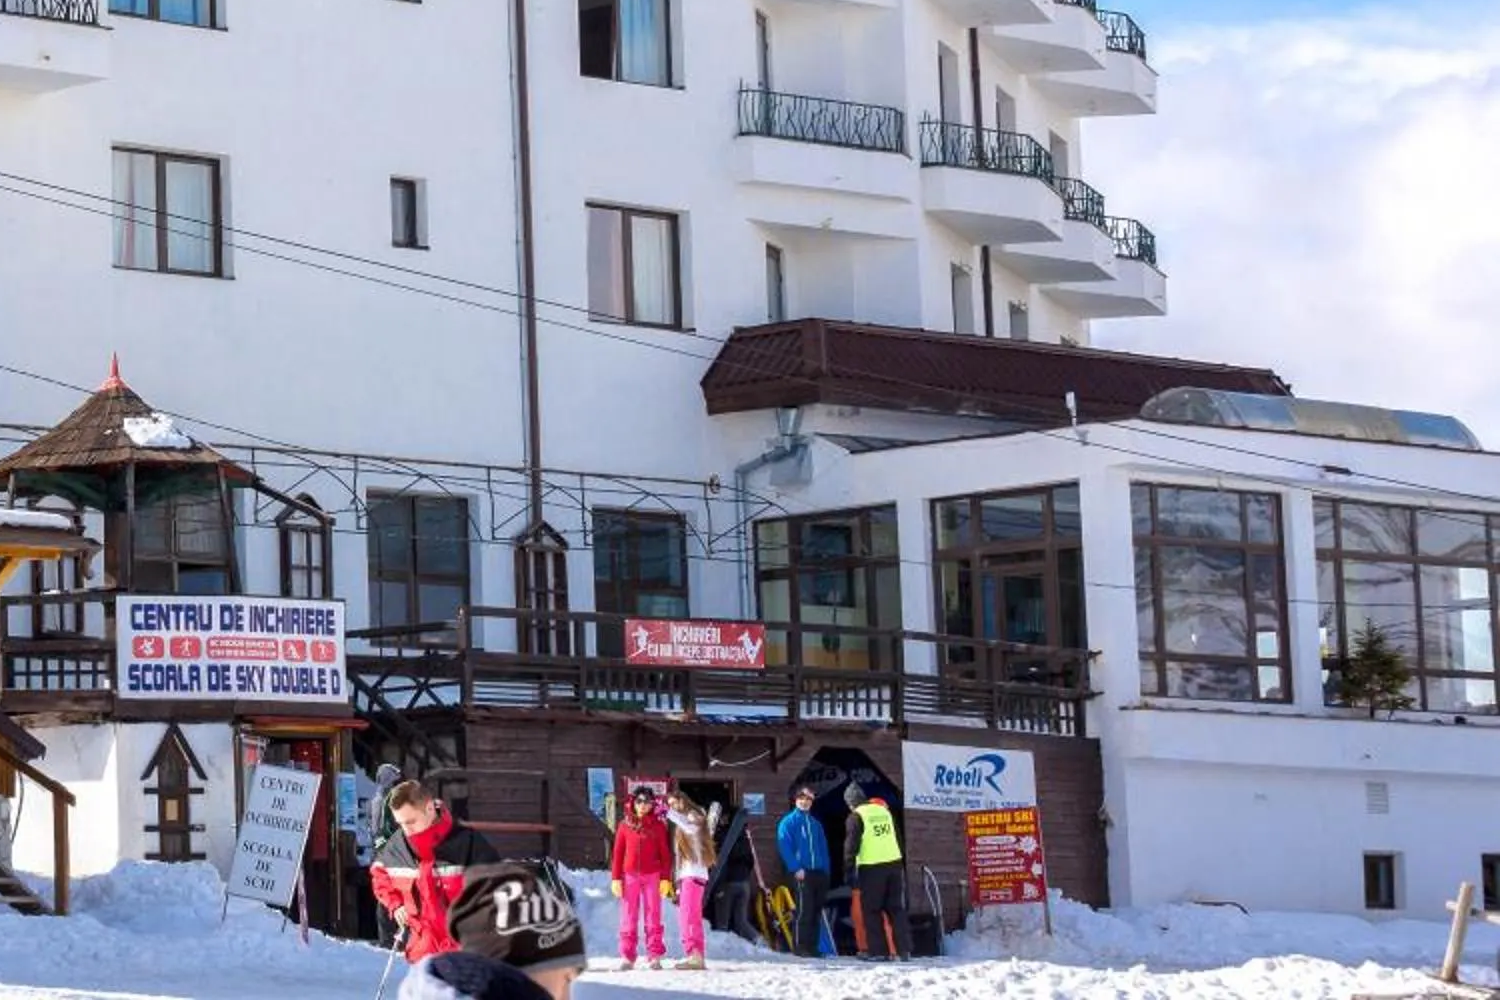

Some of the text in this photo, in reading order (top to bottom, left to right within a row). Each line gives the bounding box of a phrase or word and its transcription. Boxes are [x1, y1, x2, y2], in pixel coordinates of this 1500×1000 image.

[131, 603, 336, 636] CENTRU DE INCHIRIERE
[127, 664, 341, 695] SCOALA DE SKY DOUBLE D
[260, 775, 308, 795] CENTRU
[271, 796, 287, 811] DE
[1014, 810, 1034, 823] SKI
[873, 823, 891, 837] SKI
[242, 839, 293, 861] SCOALA
[255, 858, 272, 873] DE
